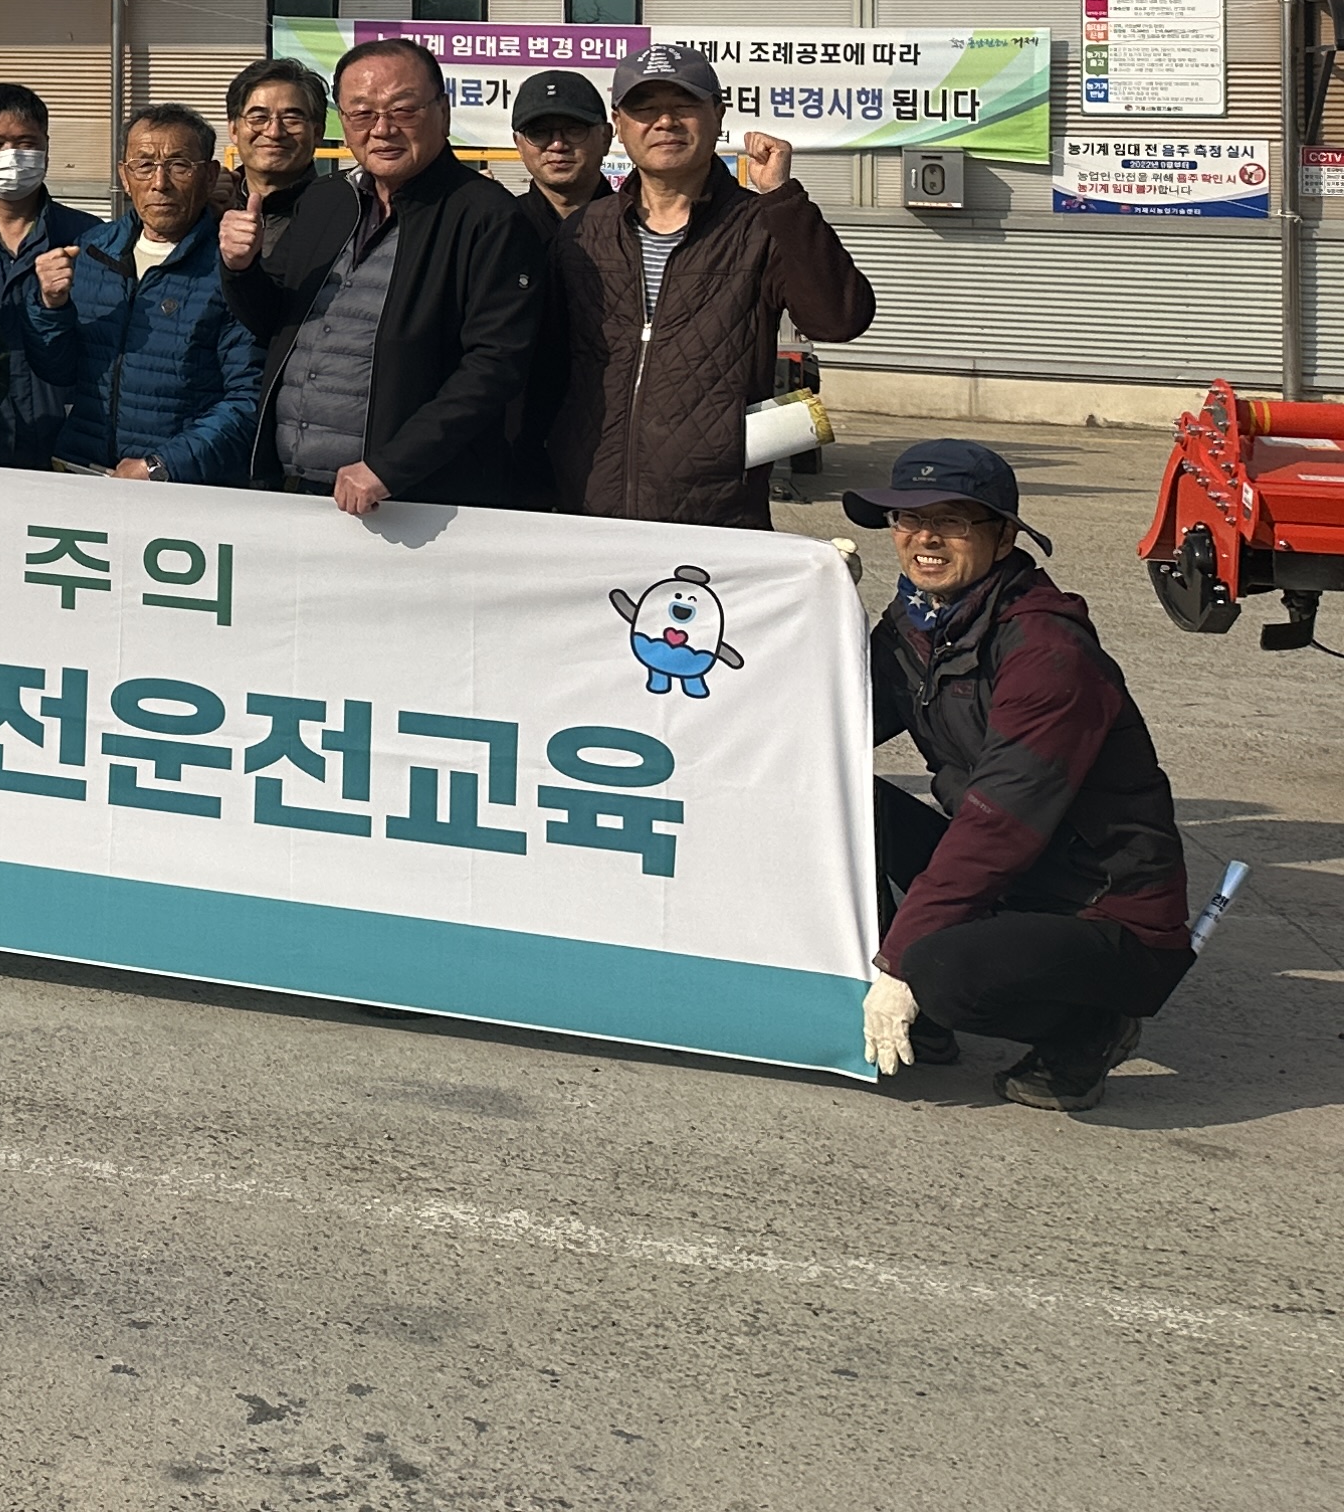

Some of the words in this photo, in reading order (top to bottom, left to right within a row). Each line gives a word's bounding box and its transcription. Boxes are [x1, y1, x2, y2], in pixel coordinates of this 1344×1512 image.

[452, 35, 522, 59] 임대료
[527, 37, 574, 60] 변경
[580, 38, 628, 61] 안내
[749, 40, 865, 65] 조례공포에
[872, 42, 922, 66] 따라
[769, 85, 884, 121] 변경시행
[891, 86, 981, 123] 됩니다
[1068, 142, 1110, 156] 농기계
[1113, 143, 1141, 157] 임대
[1145, 143, 1158, 157] 전
[1162, 143, 1190, 158] 음주
[1194, 144, 1222, 158] 측정
[1226, 144, 1254, 159] 실시
[1309, 152, 1342, 162] CCTV
[1077, 171, 1111, 182] 농업인
[1114, 172, 1148, 183] 안전을
[1226, 174, 1236, 185] 시
[1077, 183, 1109, 194] 농기계
[1112, 184, 1133, 194] 임대
